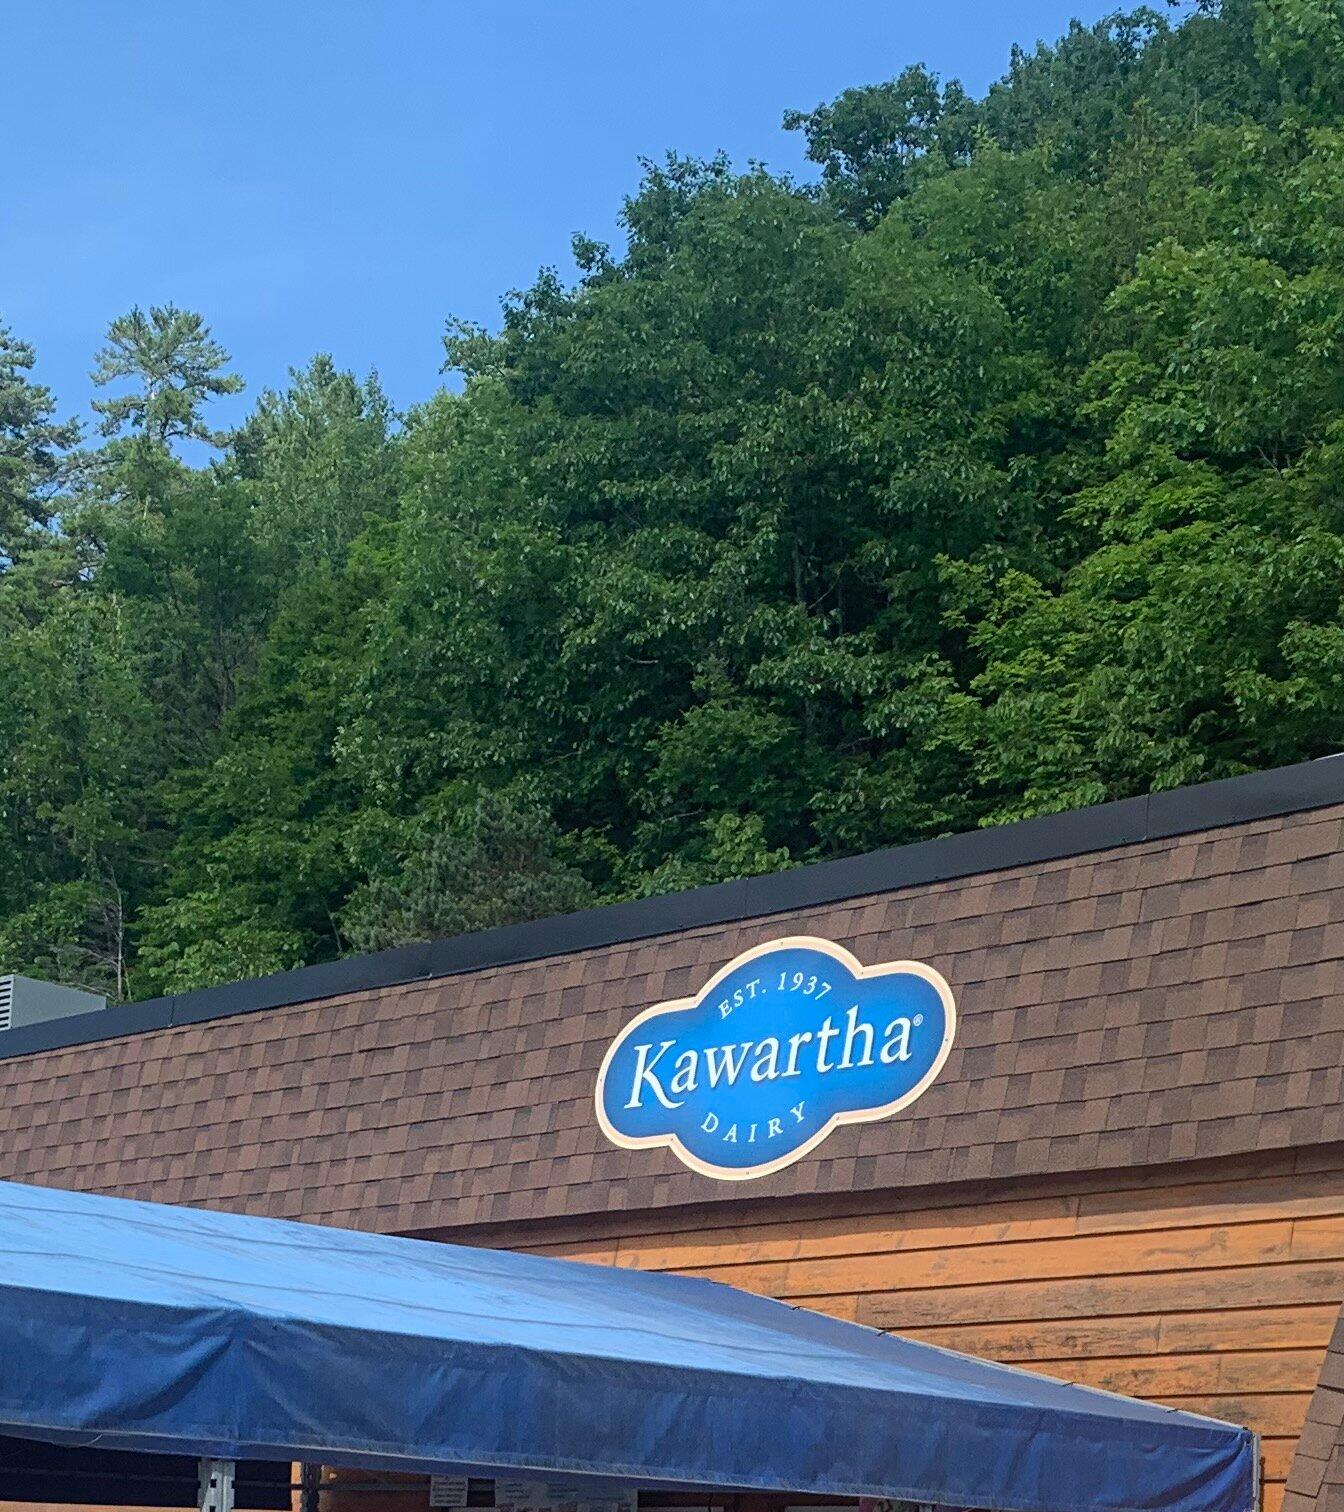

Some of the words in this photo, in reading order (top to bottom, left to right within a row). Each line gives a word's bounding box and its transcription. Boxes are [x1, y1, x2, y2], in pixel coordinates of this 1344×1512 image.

[718, 978, 768, 1020] EST.
[777, 971, 832, 1001] 1937
[624, 1005, 914, 1109] Kawartha
[700, 1100, 807, 1143] DAIRY
